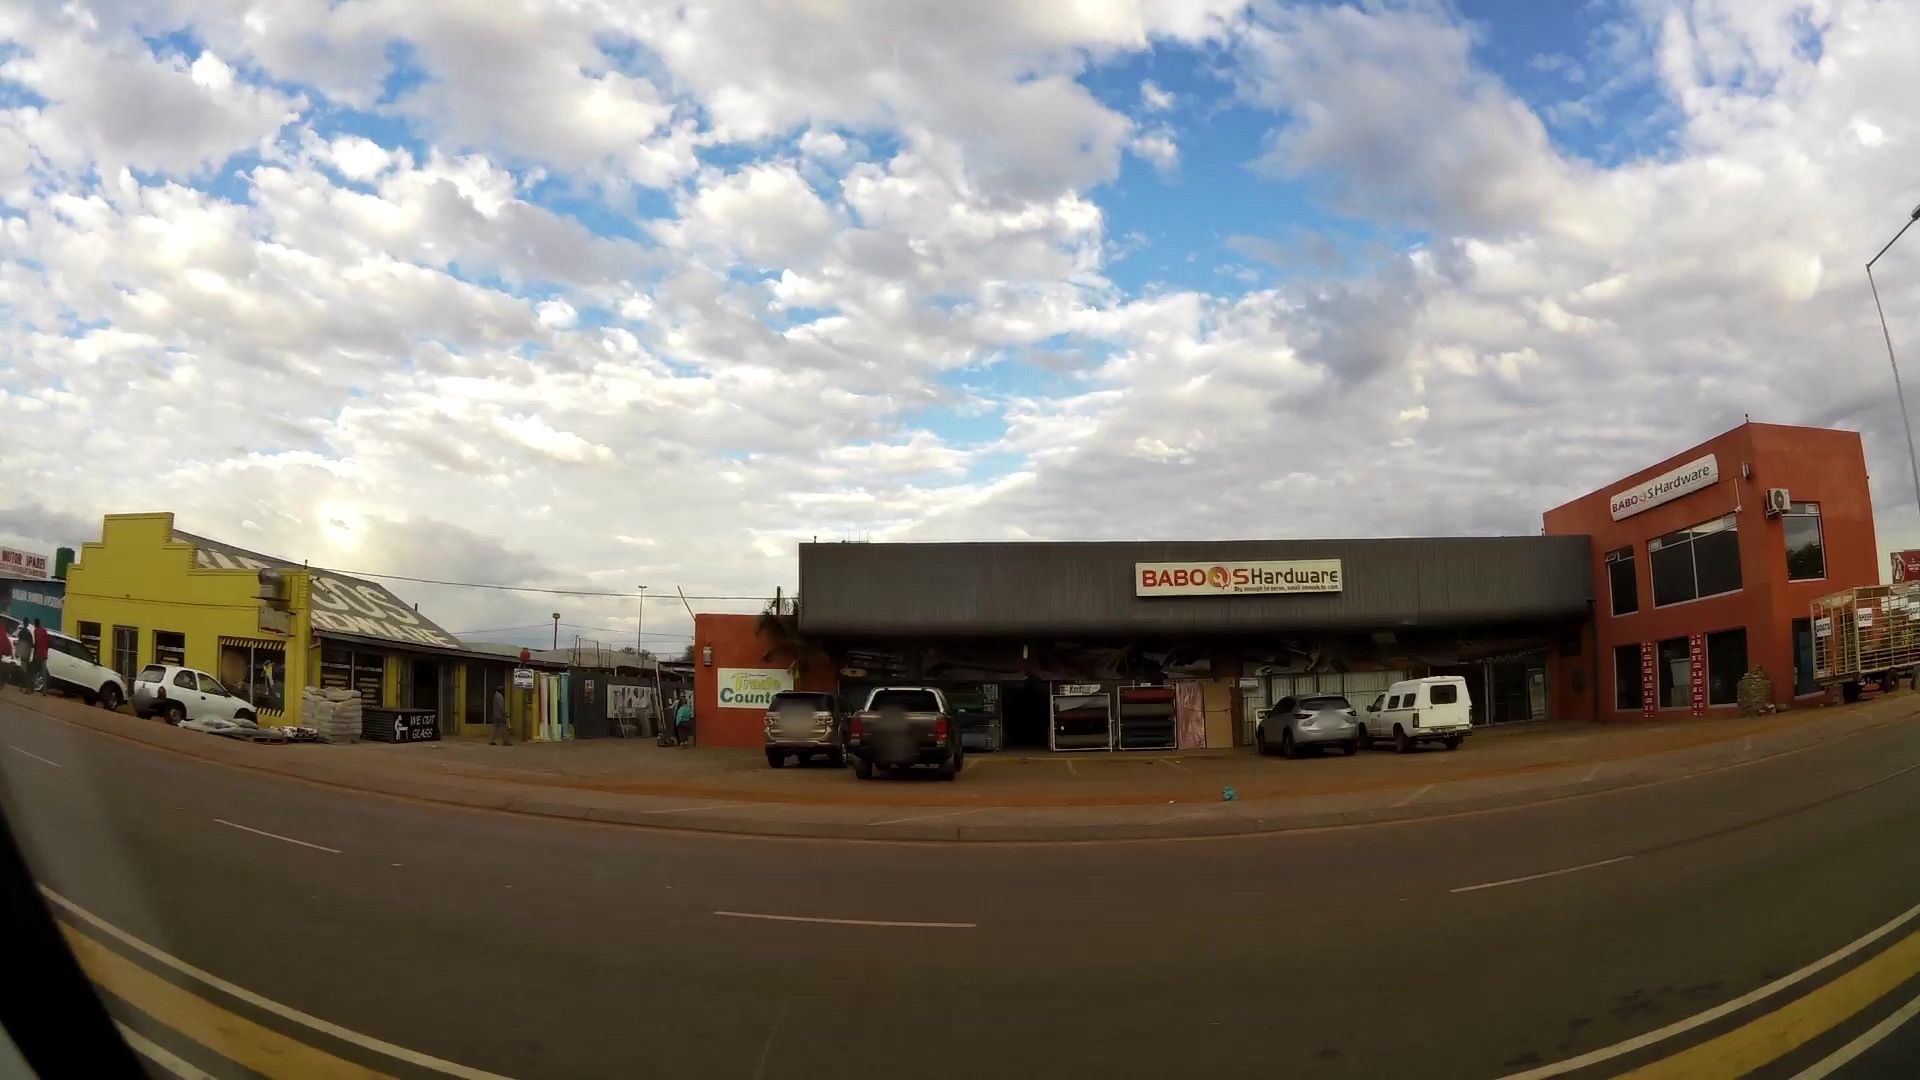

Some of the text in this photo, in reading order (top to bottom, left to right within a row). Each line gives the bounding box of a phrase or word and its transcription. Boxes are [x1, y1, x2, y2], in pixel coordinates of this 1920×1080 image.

[1655, 466, 1710, 496] Hardware
[1251, 567, 1339, 585] Hardware
[410, 715, 422, 726] WE
[412, 728, 434, 739] GLASS
